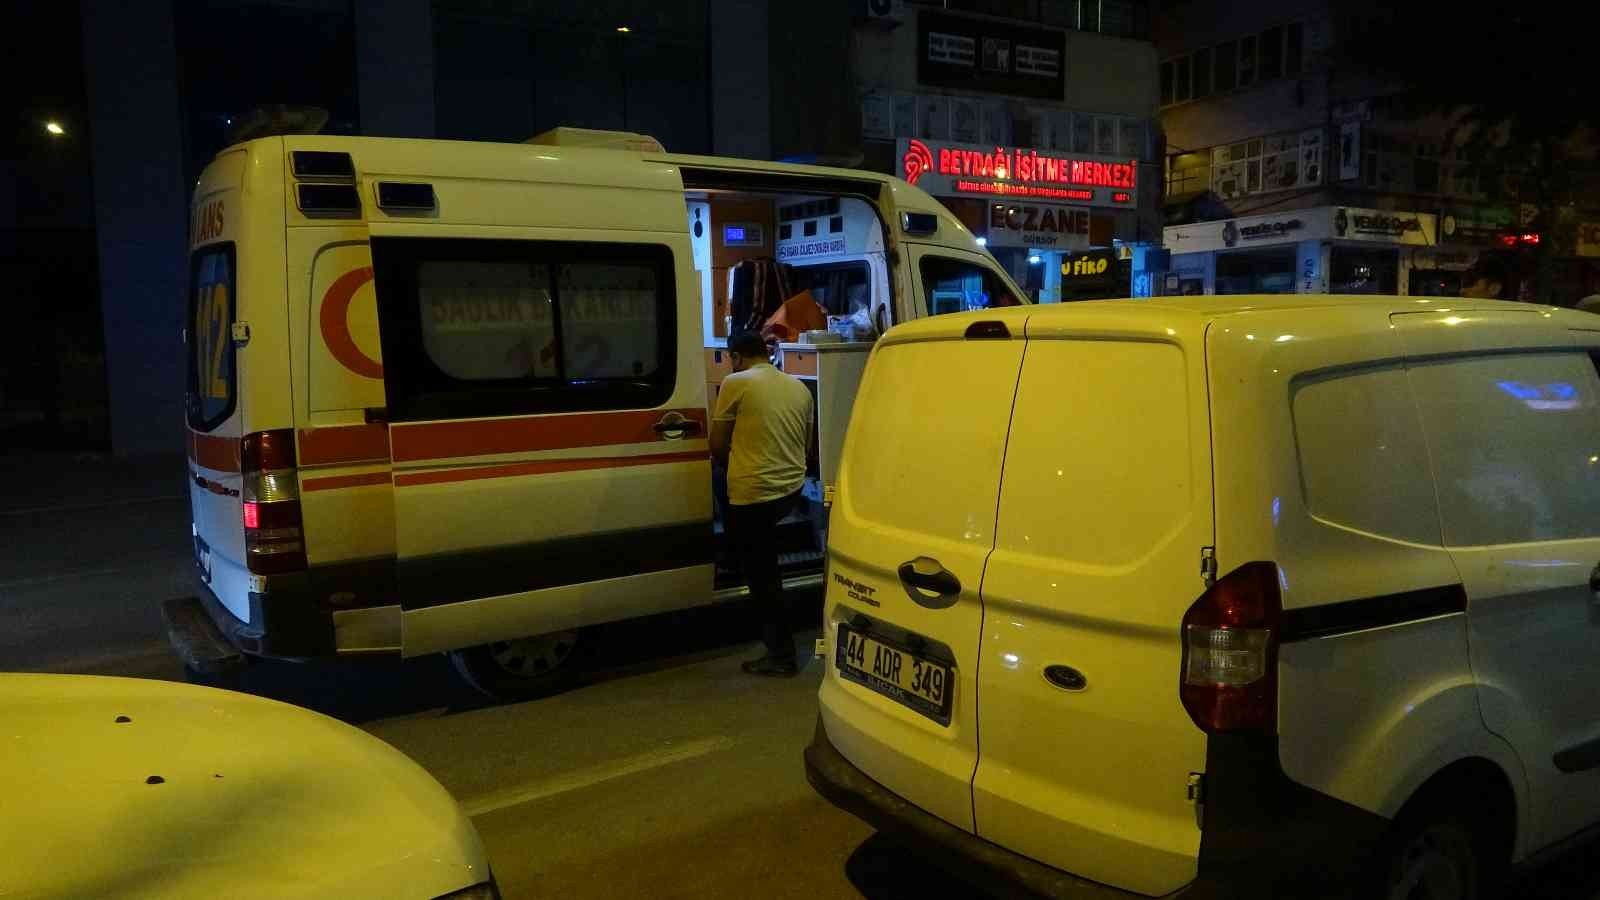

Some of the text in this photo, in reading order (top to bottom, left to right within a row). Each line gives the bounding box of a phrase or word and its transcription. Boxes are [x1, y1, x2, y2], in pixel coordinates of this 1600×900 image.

[938, 147, 1137, 189] BEYDAĞI İŞİTME MERKEZİ
[991, 203, 1089, 234] ECZANE
[833, 572, 877, 598] TRANSIT
[846, 635, 944, 702] 44 ADR 349
